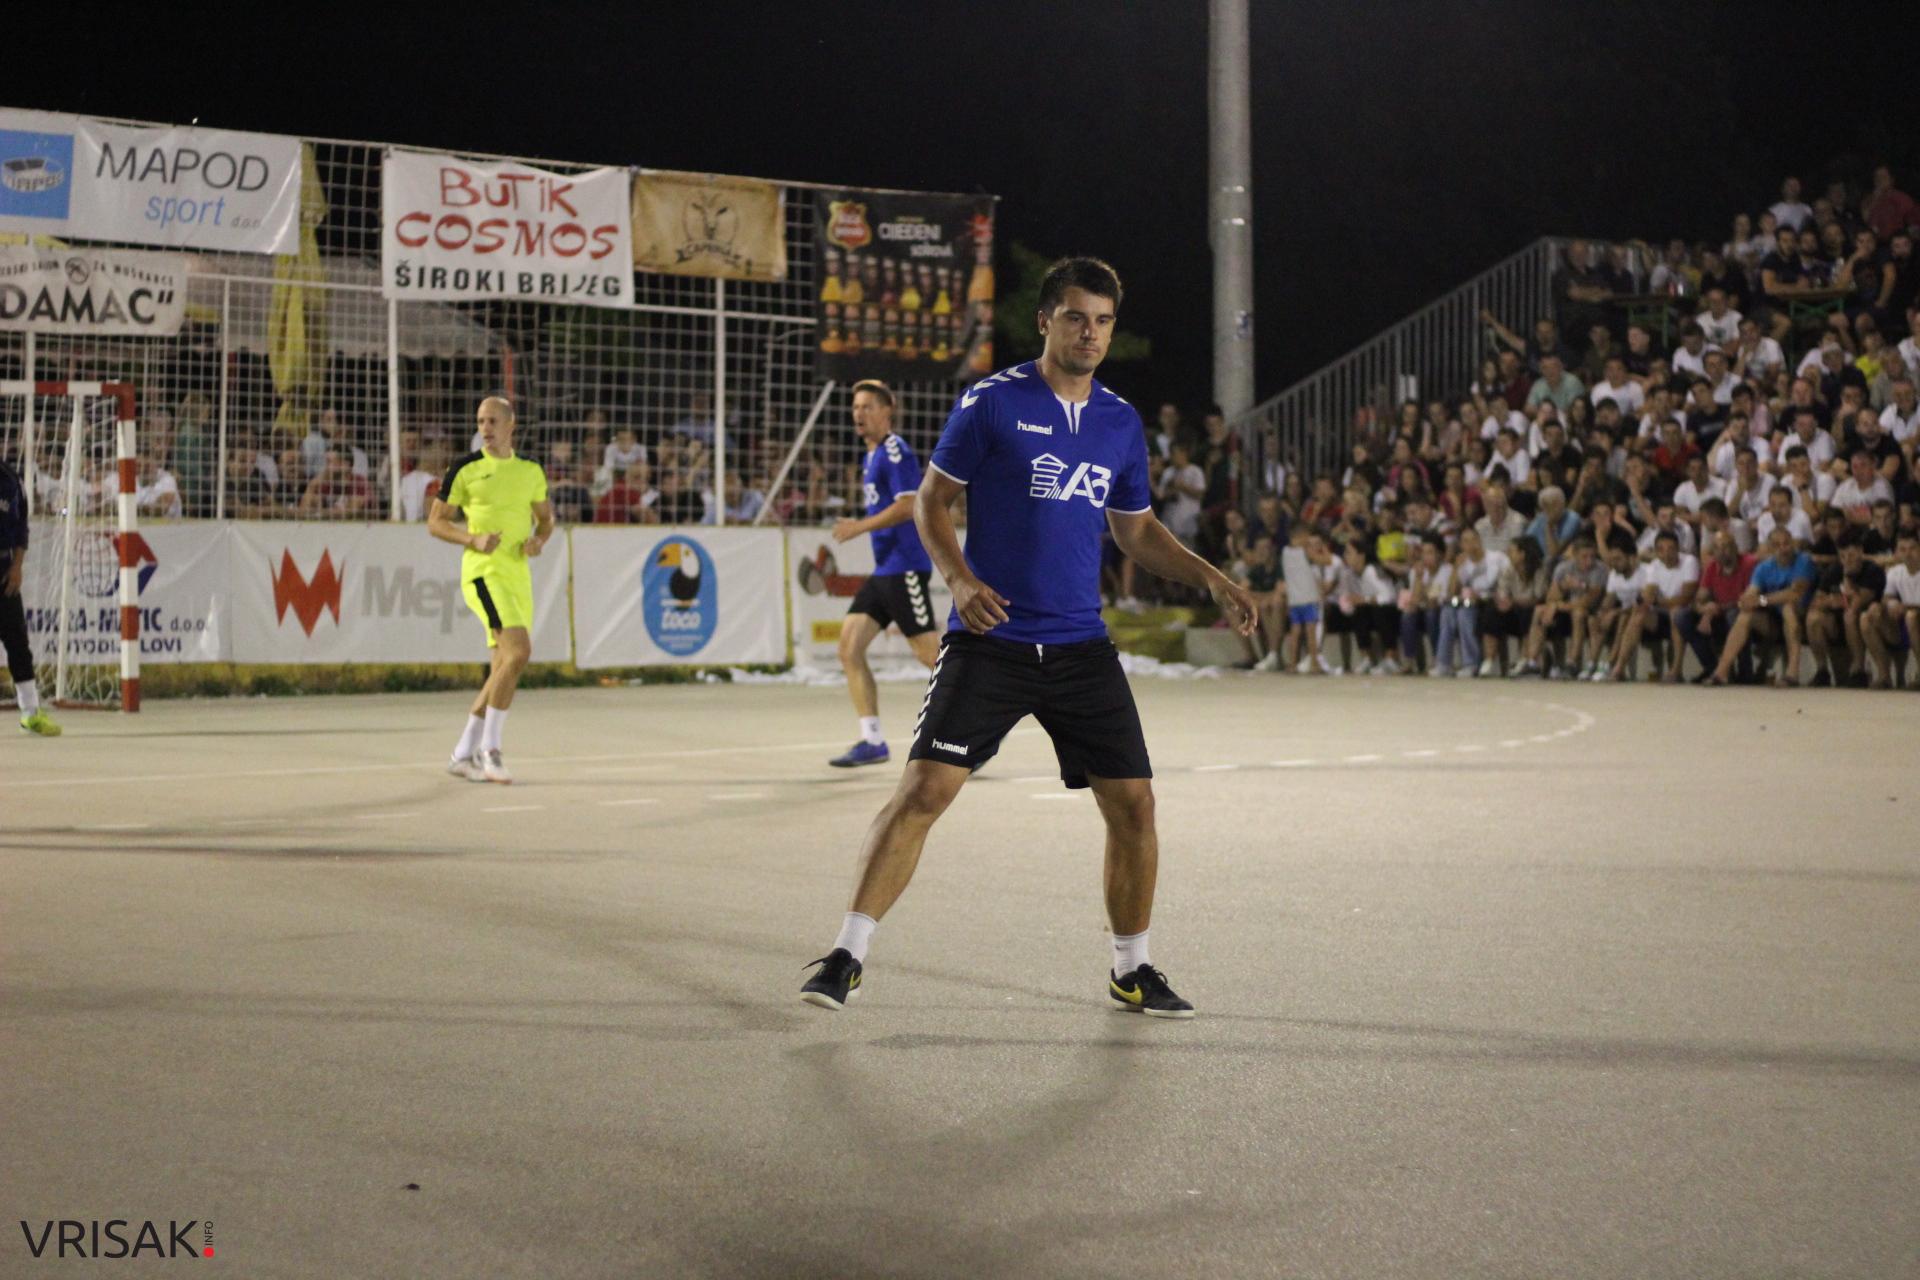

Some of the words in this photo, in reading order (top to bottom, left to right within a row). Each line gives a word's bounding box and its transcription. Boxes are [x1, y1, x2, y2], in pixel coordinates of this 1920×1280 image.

[96, 142, 269, 192] MAPOD
[145, 195, 225, 228] sport
[395, 211, 618, 259] COSMOS
[395, 260, 505, 292] ŠIROKI
[518, 272, 620, 297] BRIJEG
[1017, 420, 1052, 435] hummel
[931, 738, 969, 756] hummel
